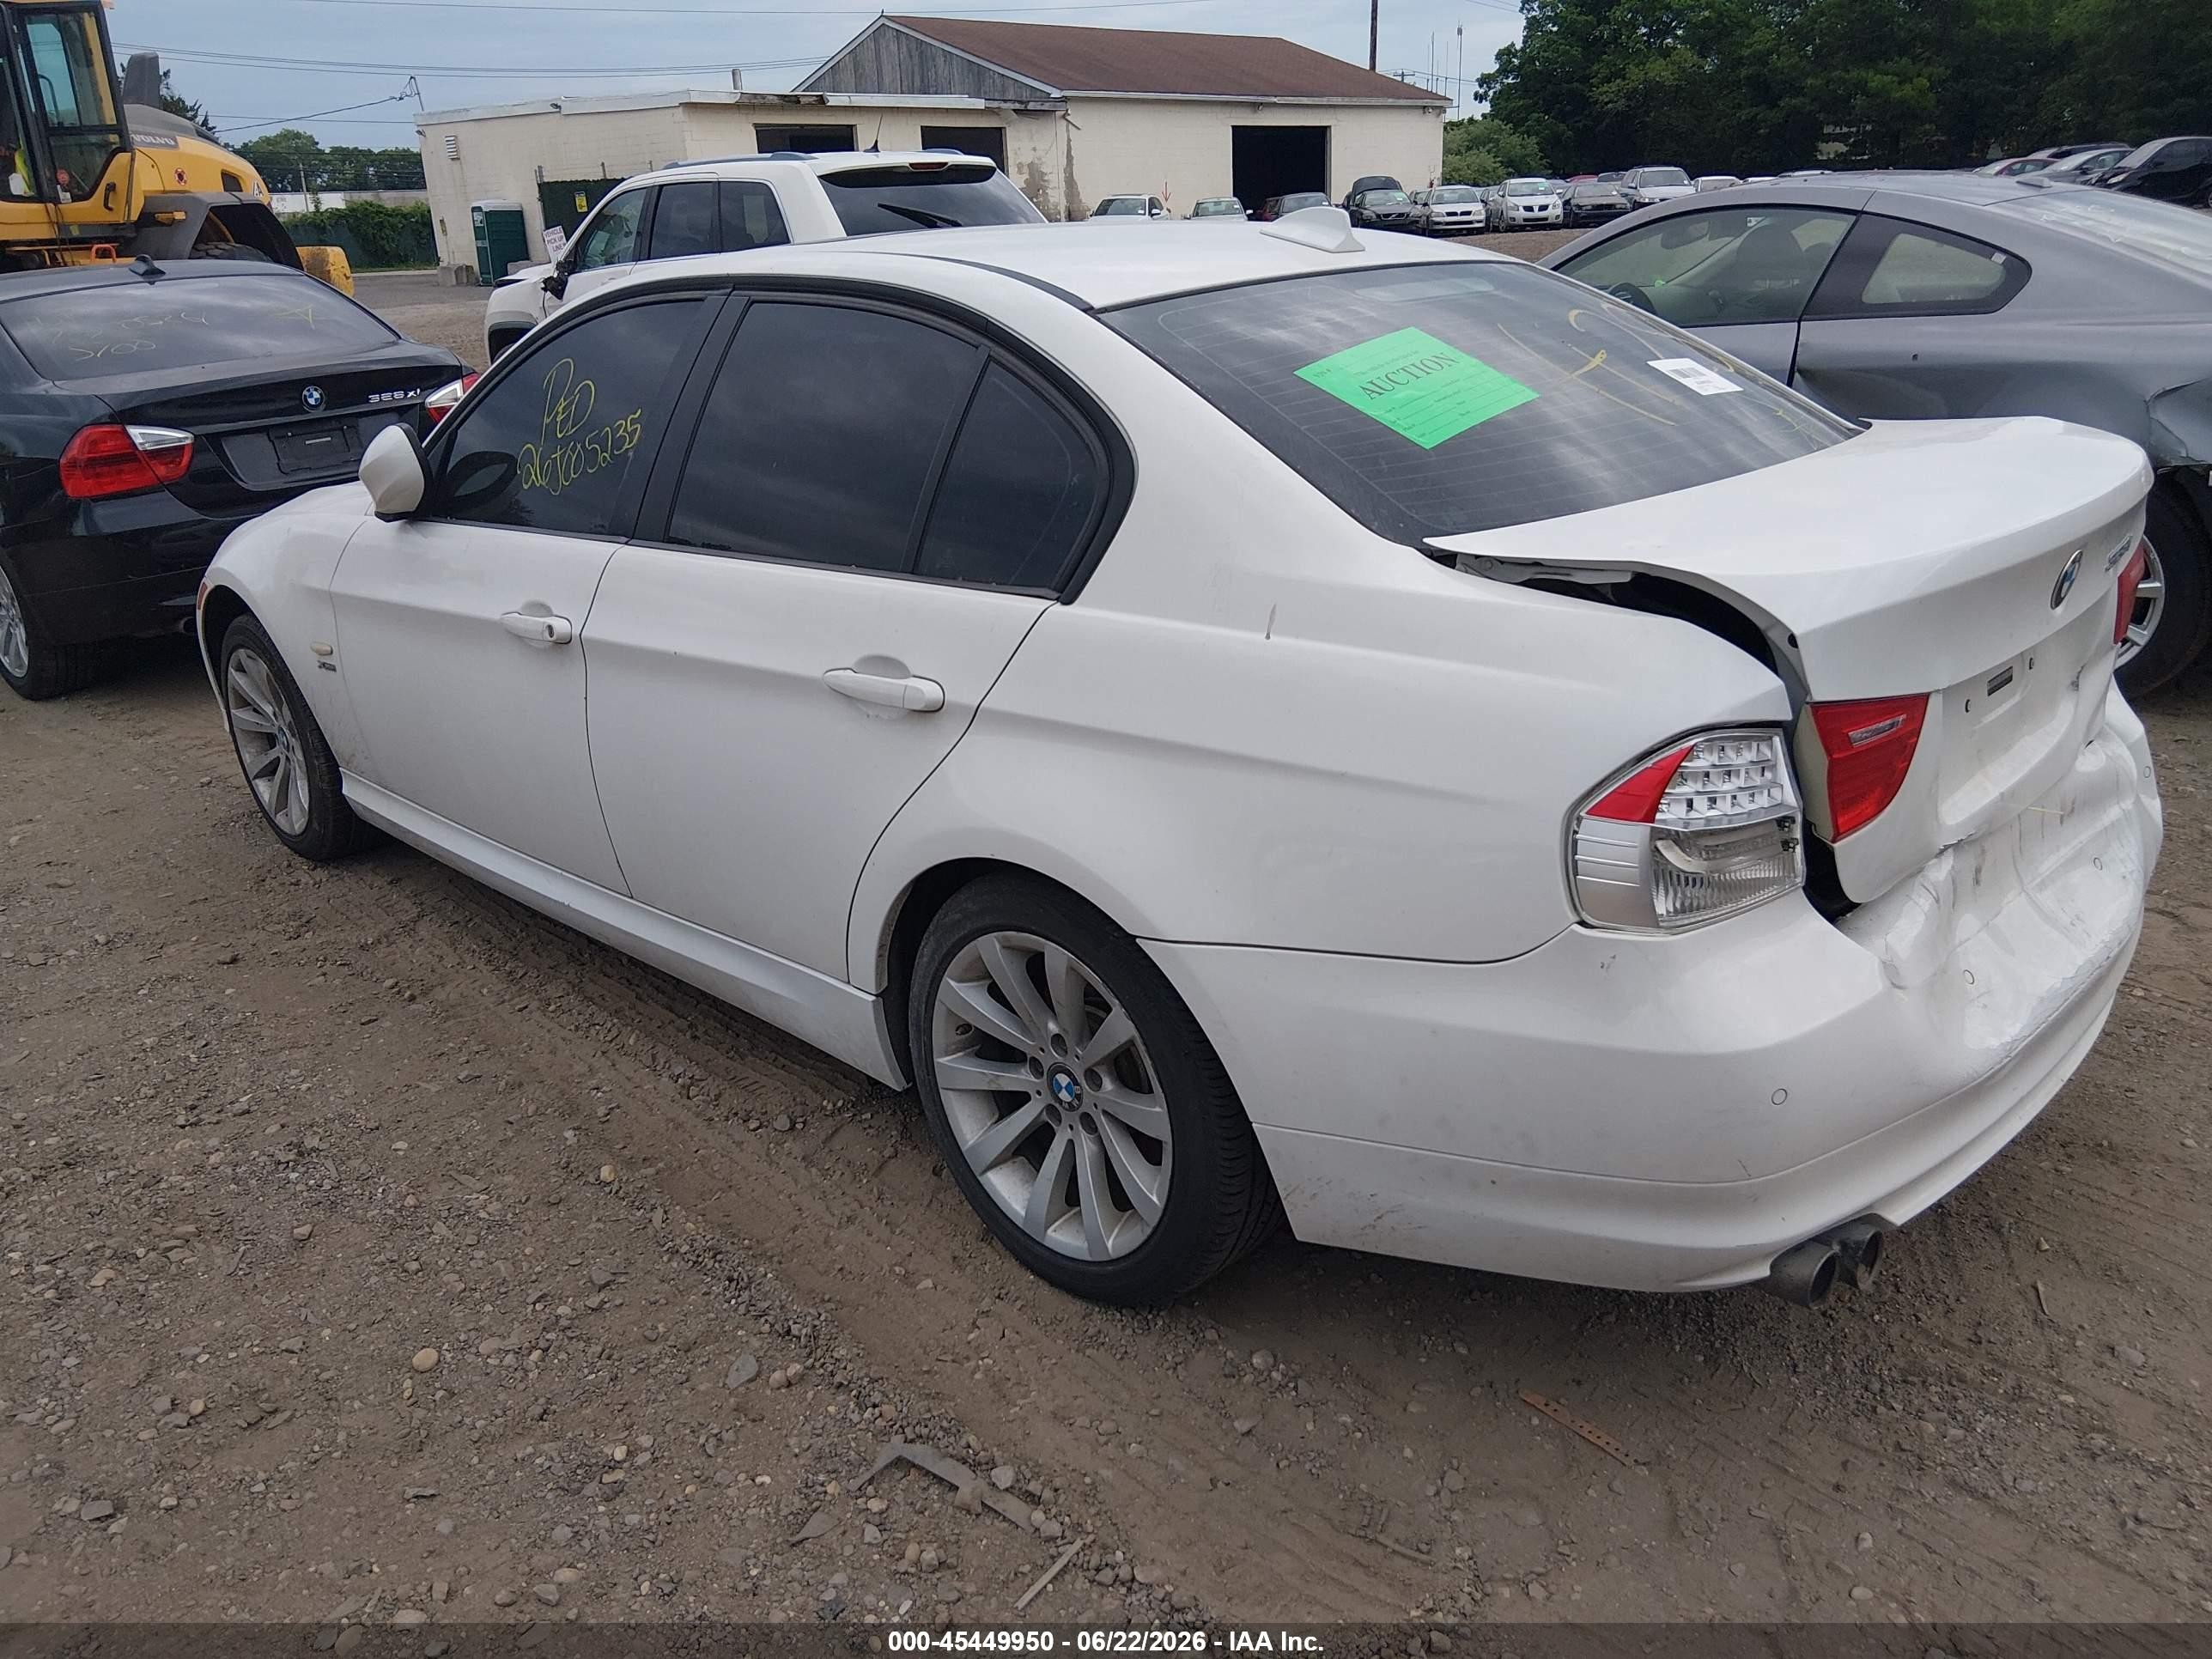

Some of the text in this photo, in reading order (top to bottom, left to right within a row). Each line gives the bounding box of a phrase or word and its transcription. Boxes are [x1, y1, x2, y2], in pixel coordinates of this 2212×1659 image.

[130, 133, 174, 145] VOLVO
[544, 227, 563, 238] VEHICLE
[1358, 352, 1460, 400] AUCTION
